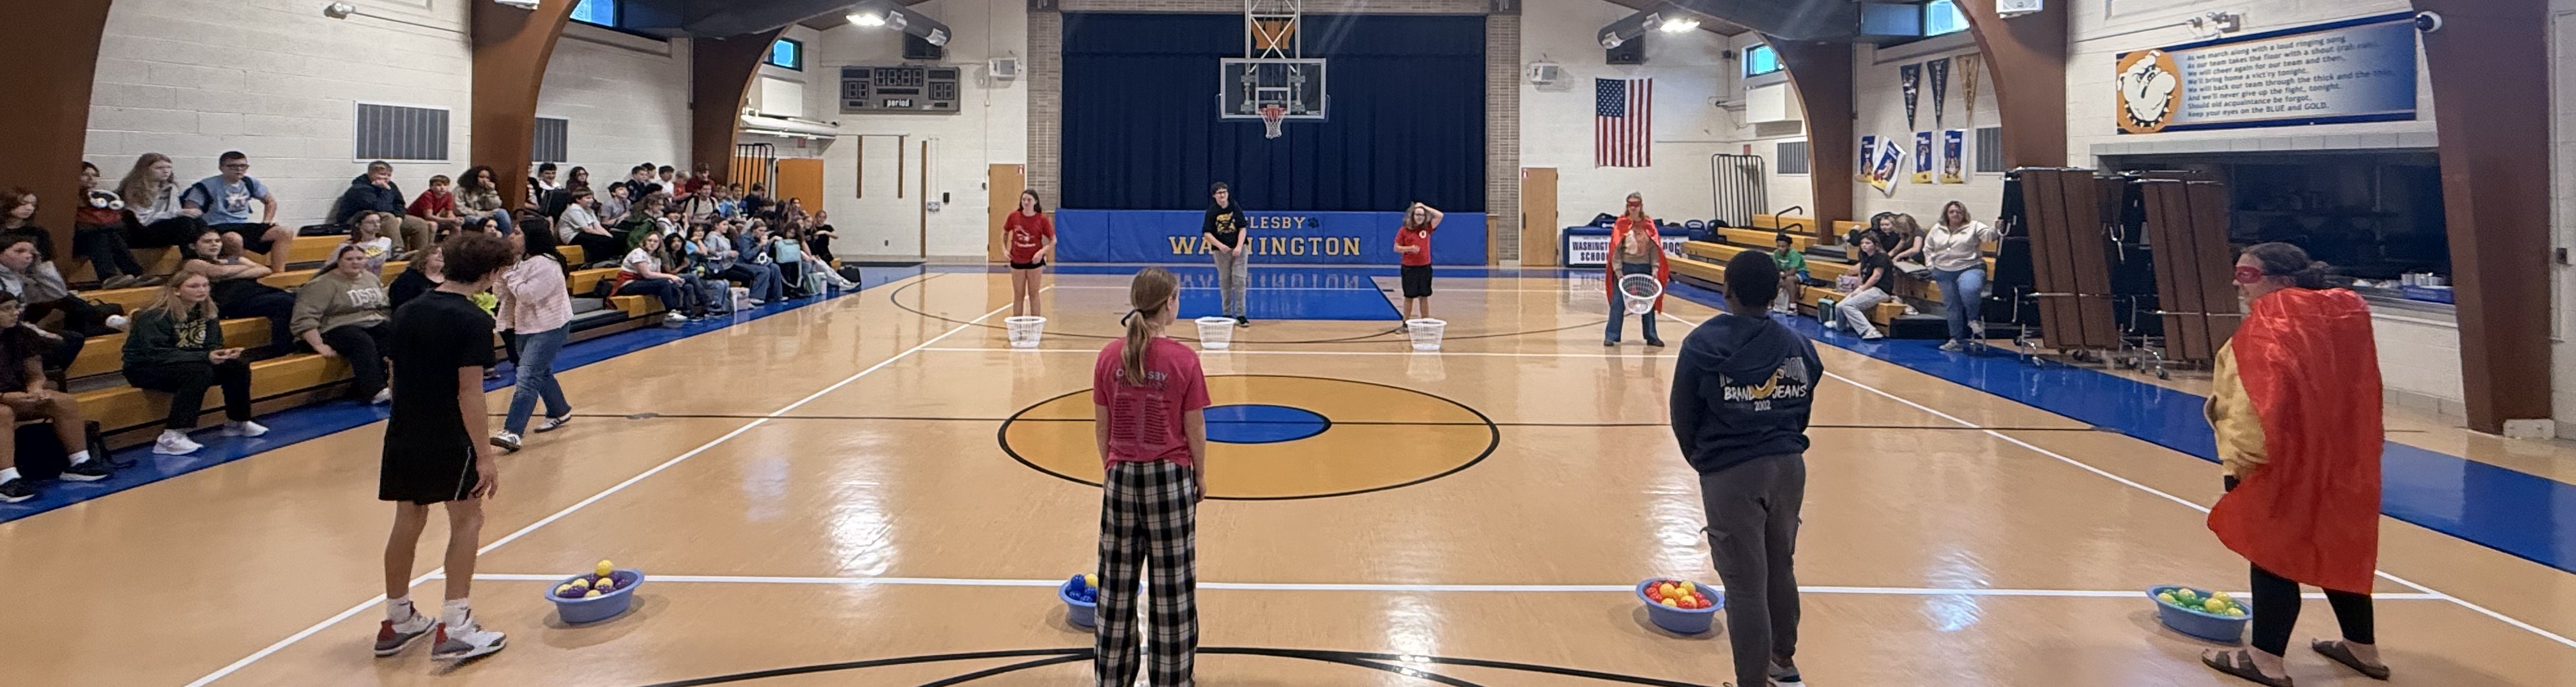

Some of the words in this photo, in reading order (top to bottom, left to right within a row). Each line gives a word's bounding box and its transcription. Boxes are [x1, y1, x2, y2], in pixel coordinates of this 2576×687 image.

[2296, 38, 2324, 47] ringing
[2235, 65, 2253, 73] again
[2266, 78, 2295, 86] through
[2313, 73, 2334, 82] thick
[2337, 72, 2353, 80] and
[887, 99, 909, 107] period
[2224, 98, 2271, 107] acquaintance
[2288, 103, 2302, 111] and
[1772, 385, 1807, 399] JEANS
